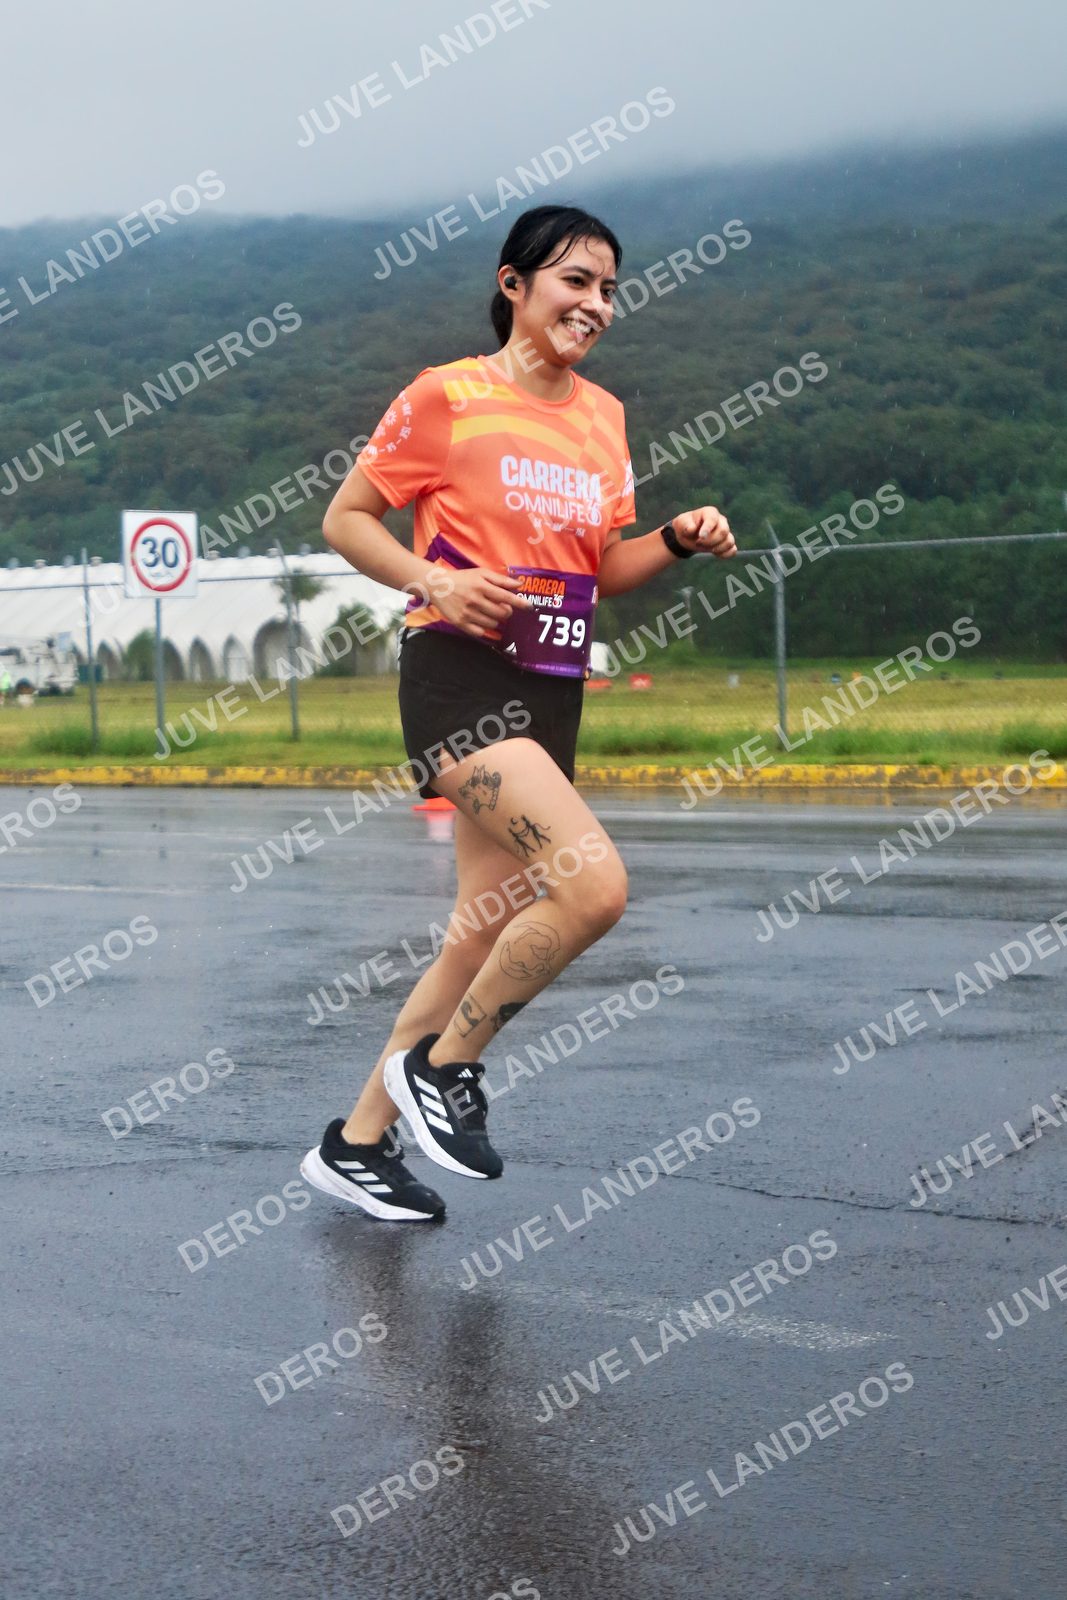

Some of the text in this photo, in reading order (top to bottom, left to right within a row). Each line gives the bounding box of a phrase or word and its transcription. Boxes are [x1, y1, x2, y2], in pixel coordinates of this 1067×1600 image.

[501, 455, 601, 503] CARRERA
[505, 490, 585, 523] OMNILIFE
[142, 537, 180, 568] 30
[538, 614, 586, 648] 739
